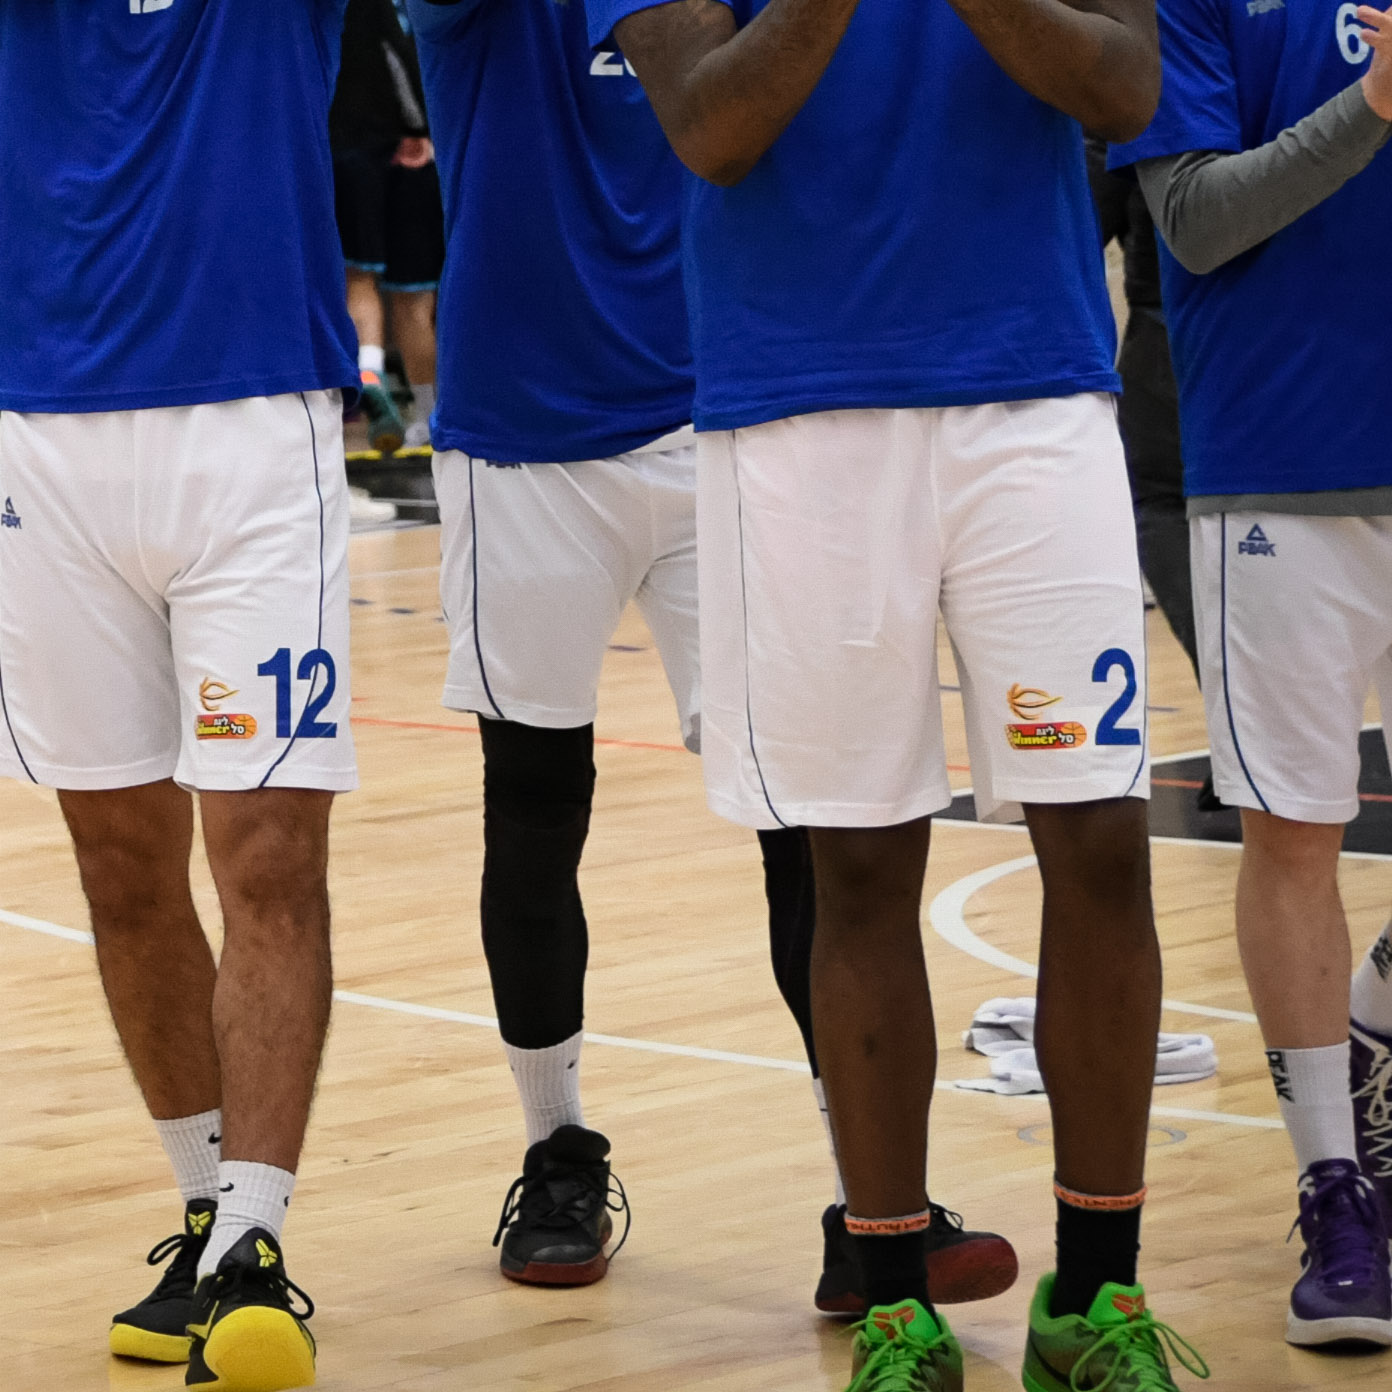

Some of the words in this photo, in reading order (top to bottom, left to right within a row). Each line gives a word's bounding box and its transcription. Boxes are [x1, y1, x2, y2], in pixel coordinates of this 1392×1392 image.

[1238, 541, 1277, 557] PEAK
[257, 647, 338, 739] 12
[1091, 648, 1142, 747] 2
